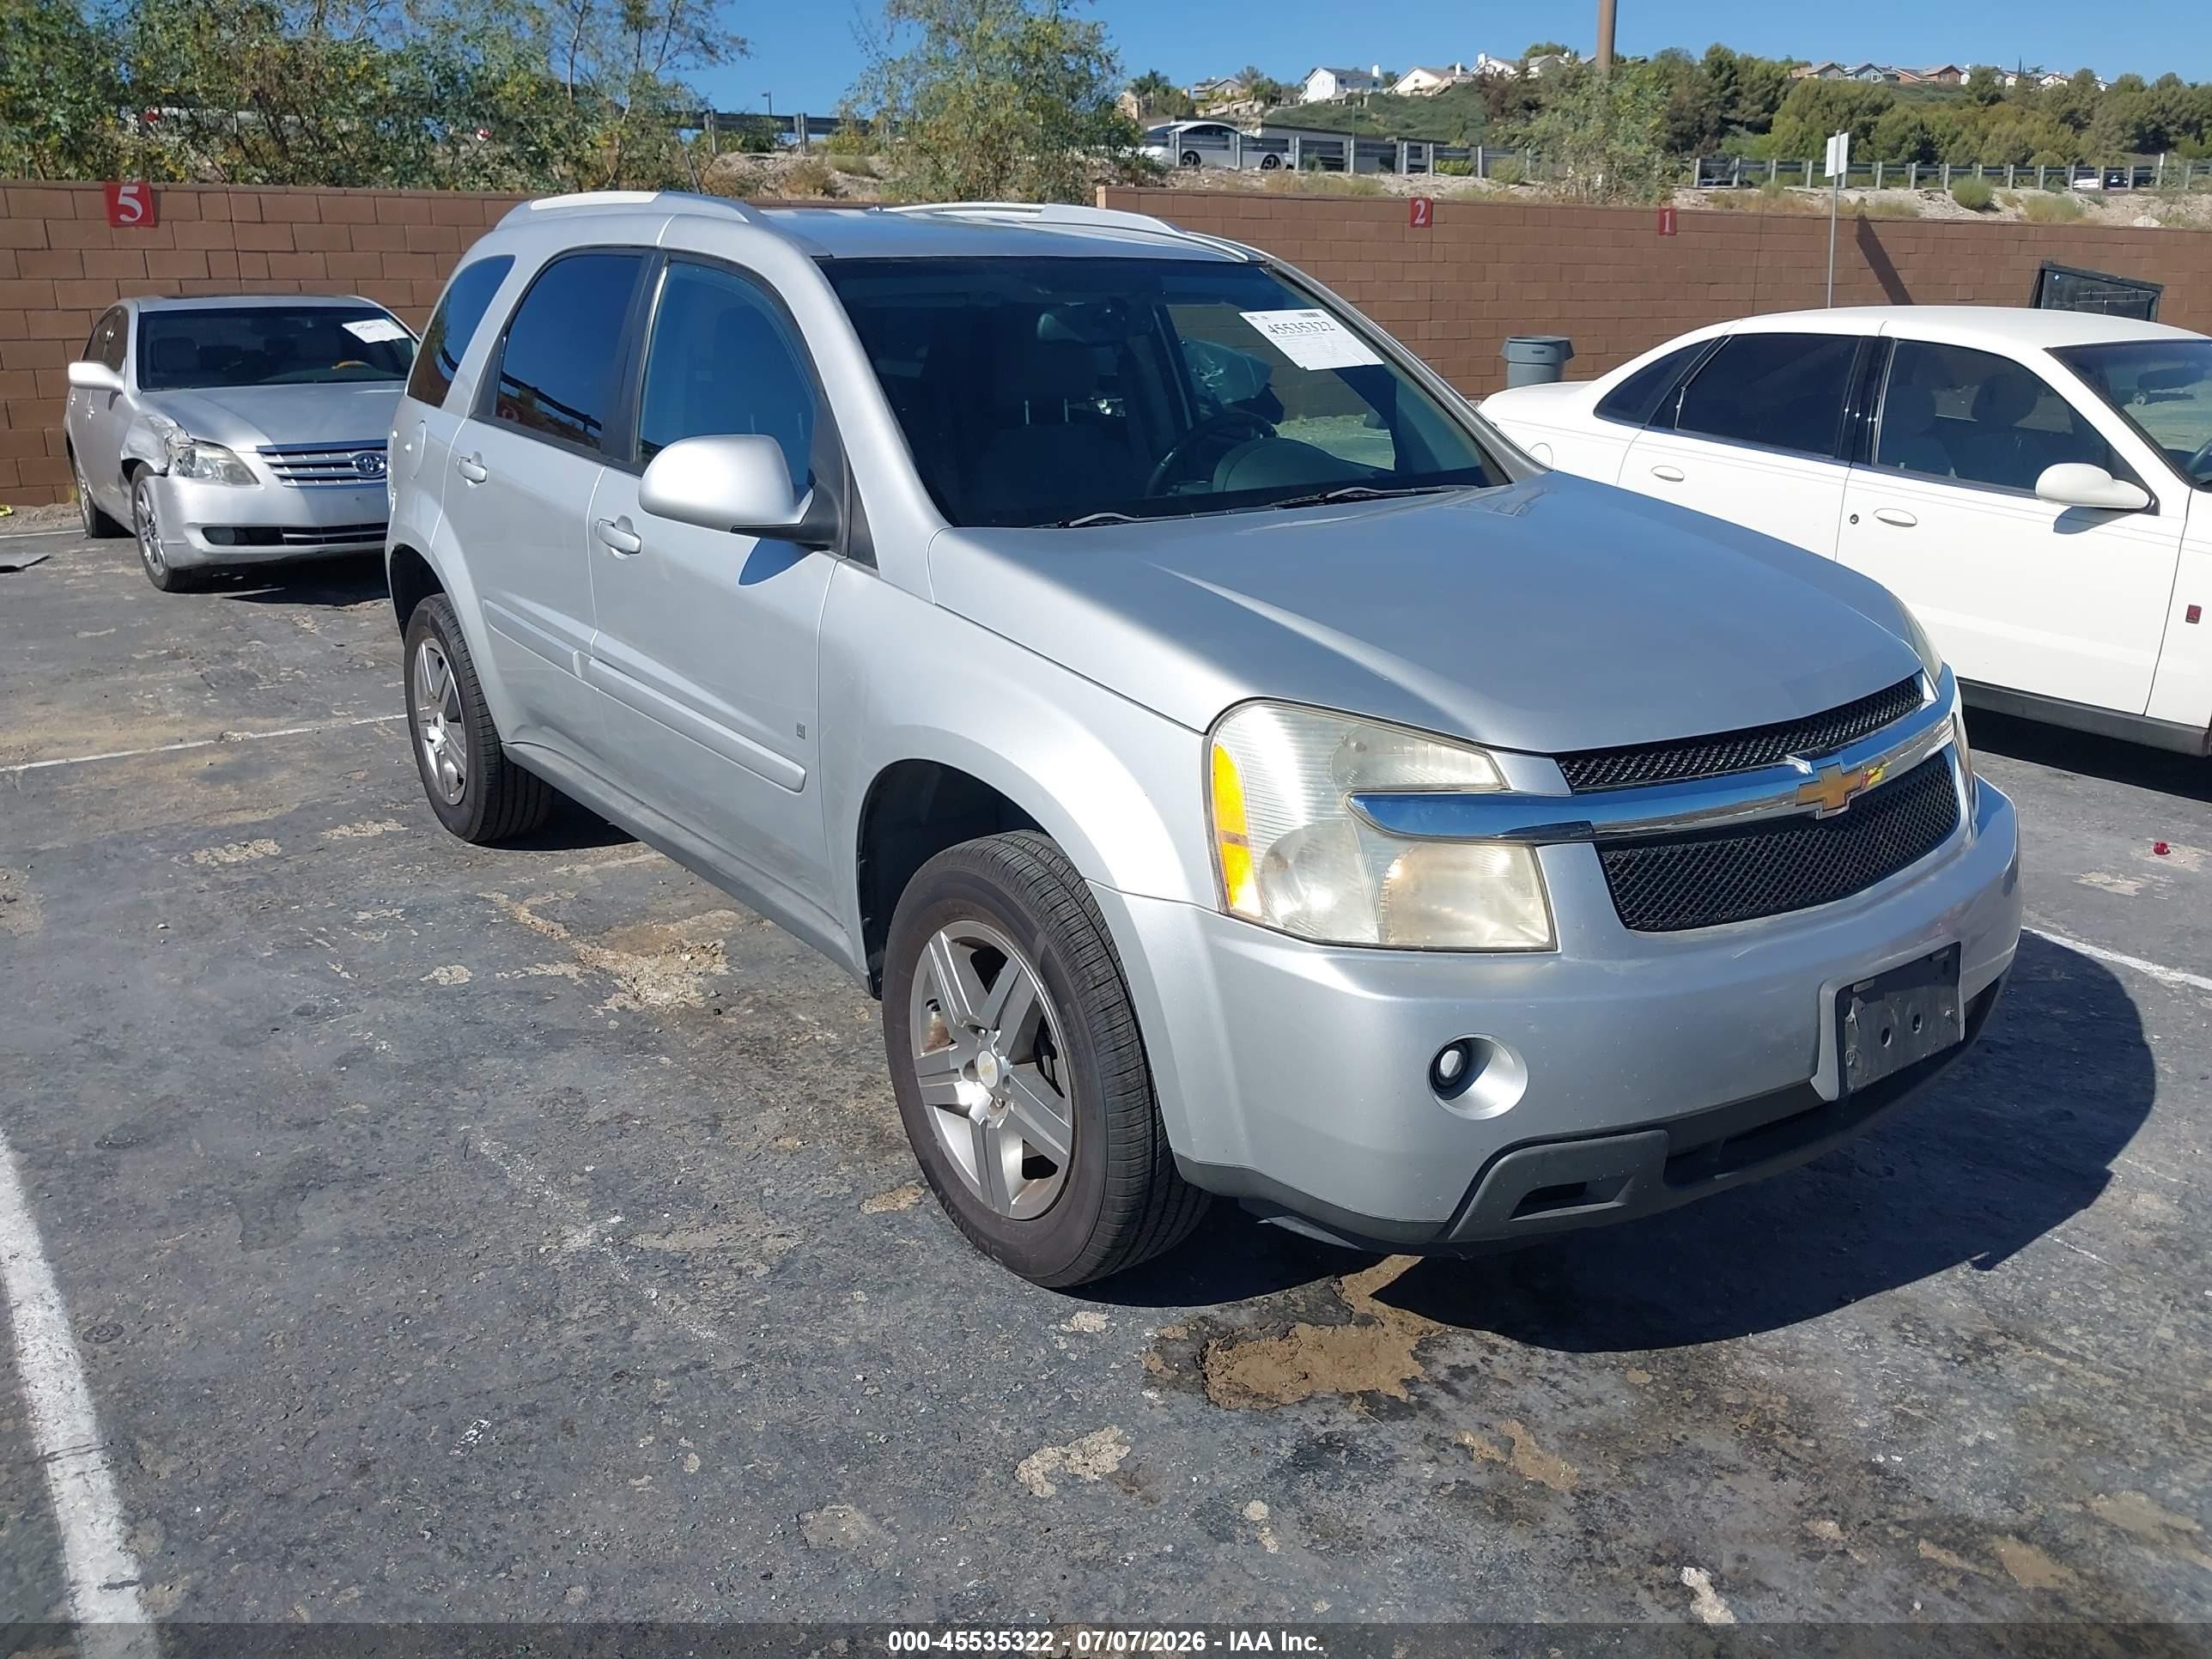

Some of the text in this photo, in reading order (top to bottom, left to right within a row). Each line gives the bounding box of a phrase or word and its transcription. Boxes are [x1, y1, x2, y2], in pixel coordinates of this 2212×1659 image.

[118, 185, 143, 222] 5
[1414, 199, 1425, 224] 2
[1664, 211, 1670, 233] 1
[1267, 321, 1335, 335] 45535322
